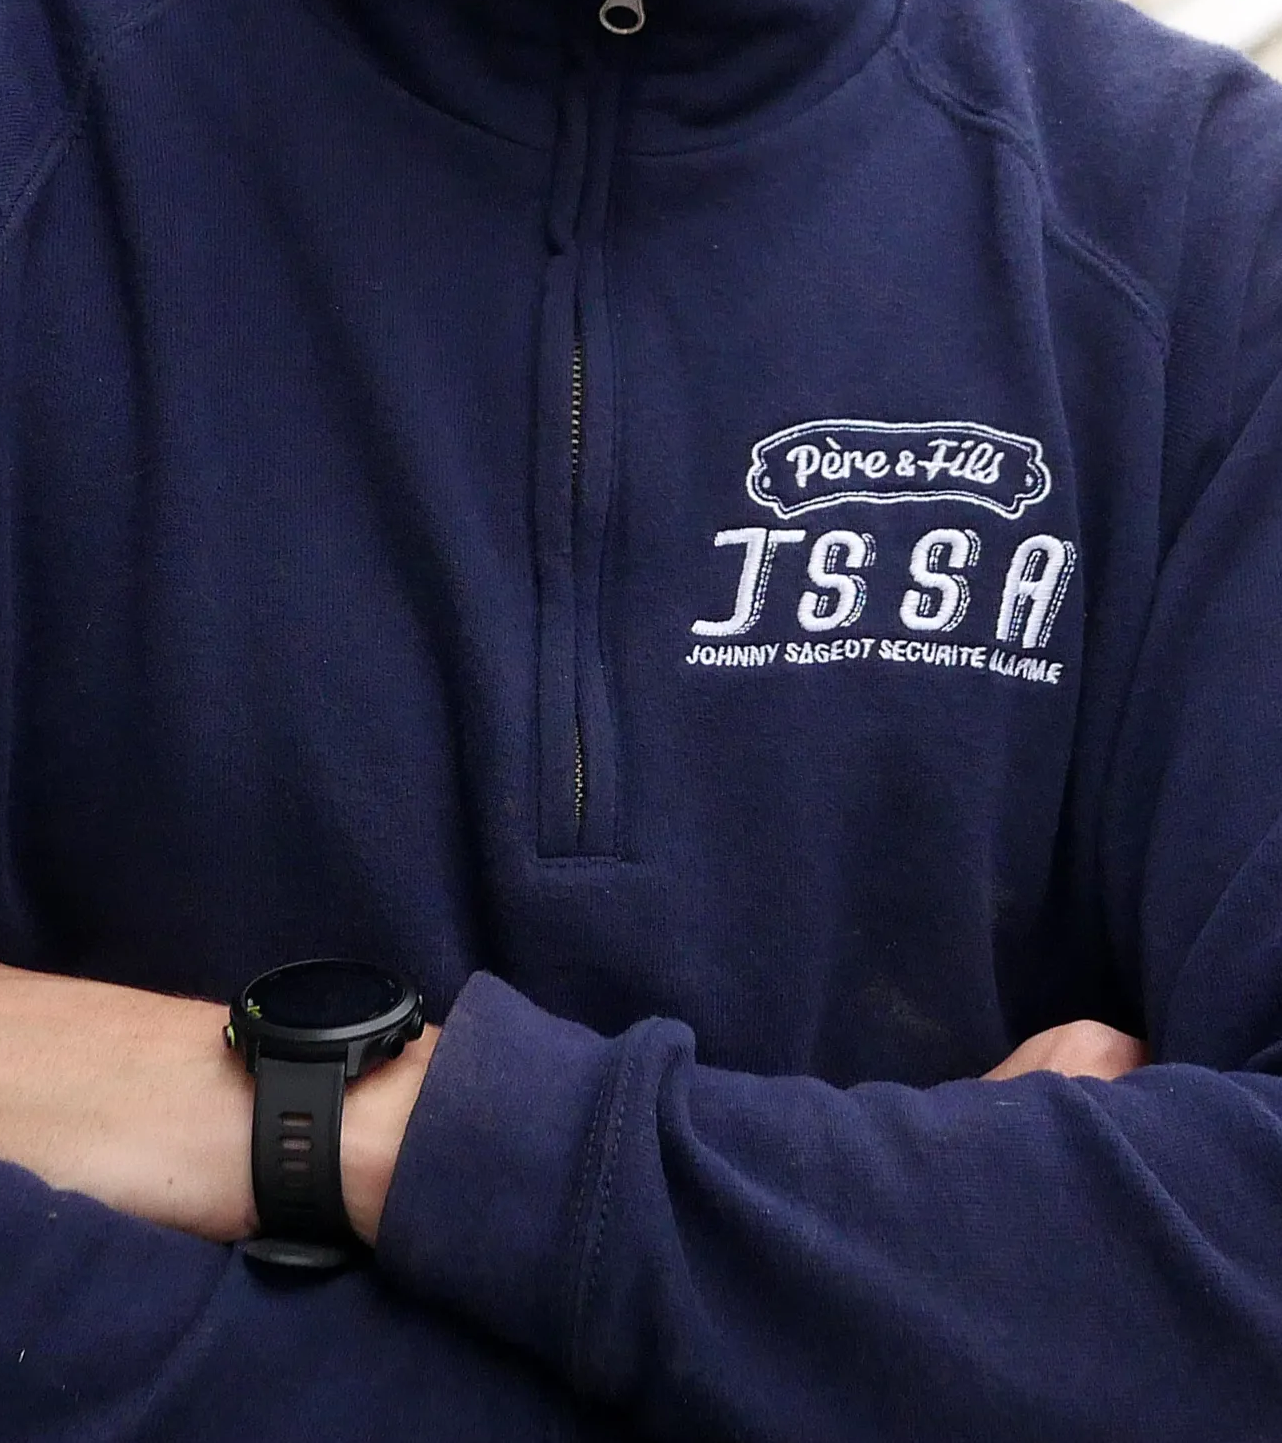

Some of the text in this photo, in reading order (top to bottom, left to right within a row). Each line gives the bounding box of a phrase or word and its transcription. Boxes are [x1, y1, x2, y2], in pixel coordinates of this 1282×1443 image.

[786, 436, 1006, 487] Père & Fils
[685, 643, 780, 667] JOHNNY
[878, 639, 986, 669] SECURITE
